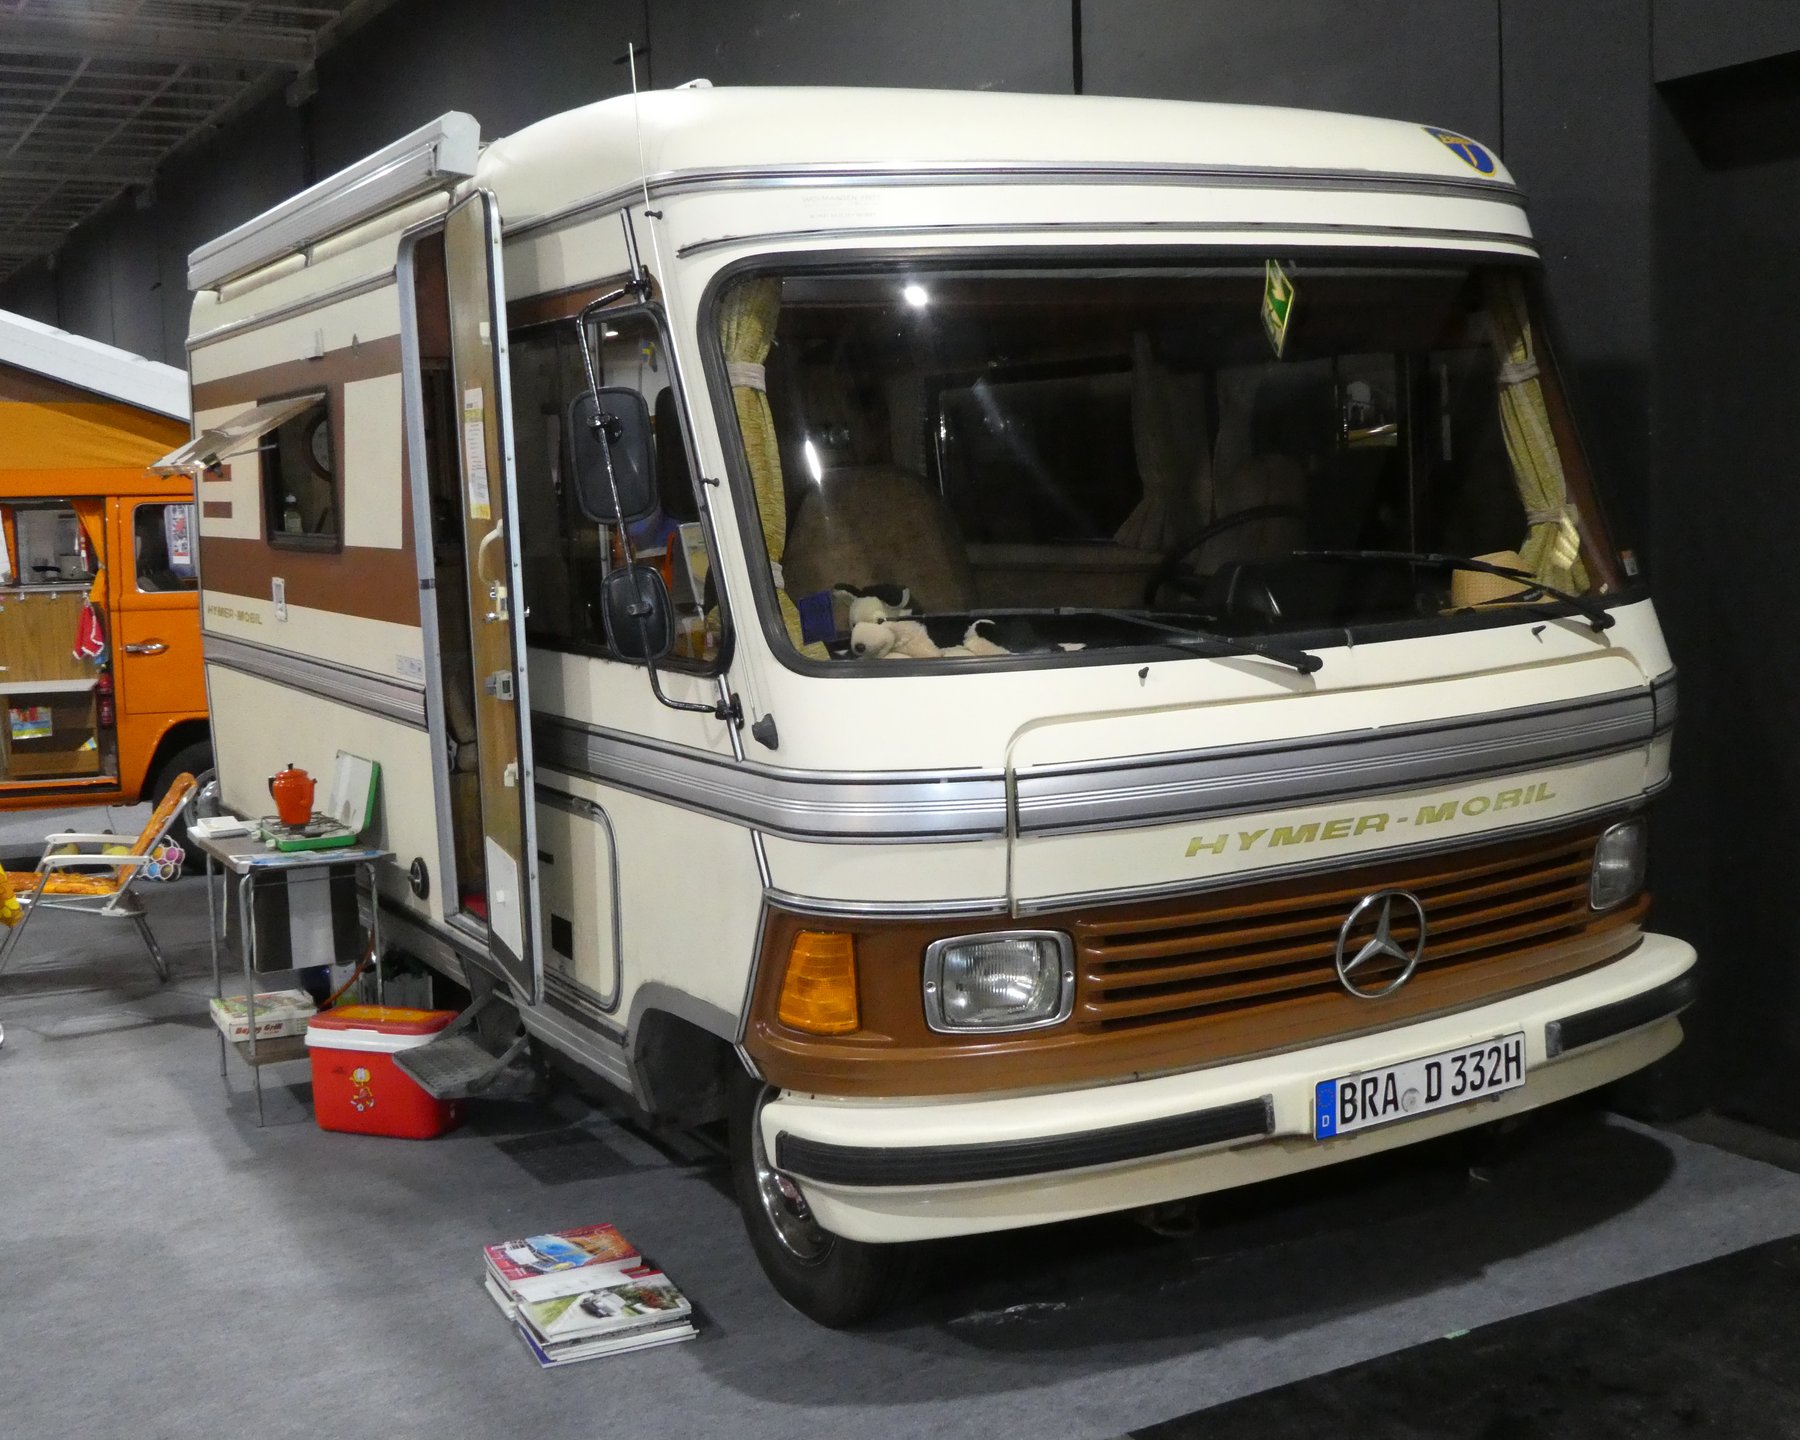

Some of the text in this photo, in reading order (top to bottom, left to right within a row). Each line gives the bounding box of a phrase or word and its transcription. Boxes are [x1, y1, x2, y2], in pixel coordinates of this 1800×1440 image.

[1340, 1039, 1521, 1125] BRA D 332H
[1321, 1114, 1330, 1128] D
